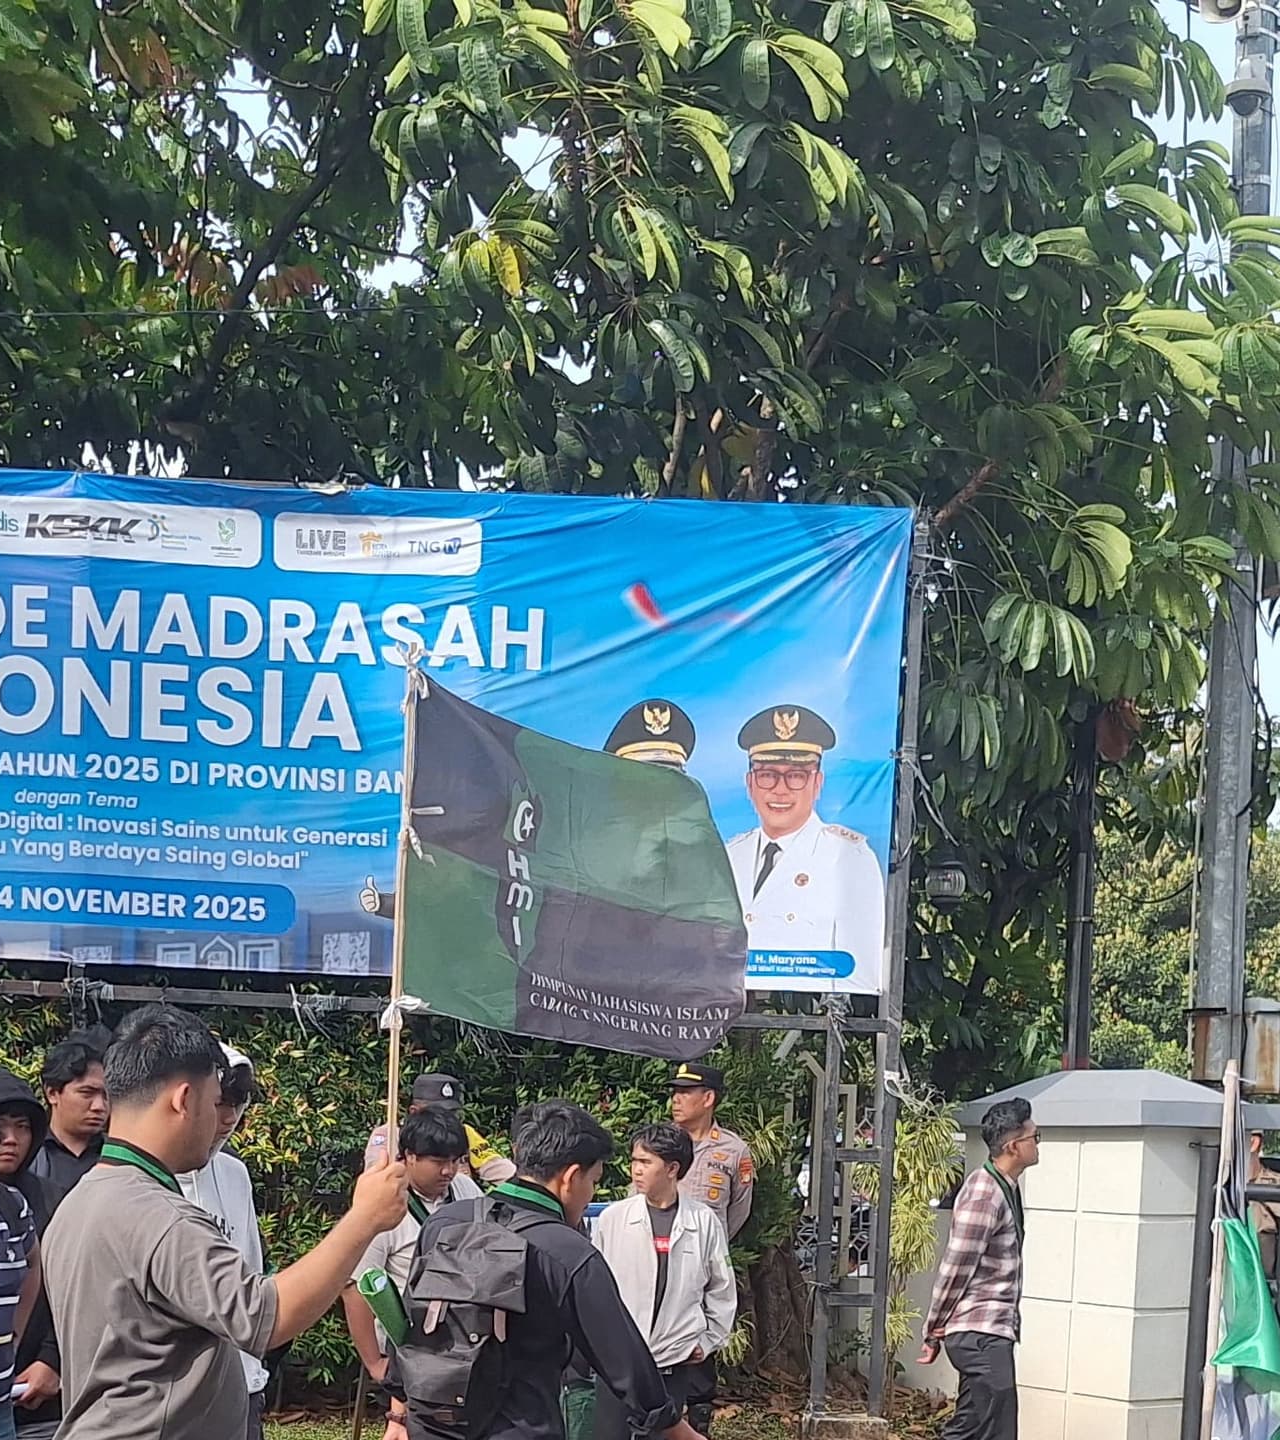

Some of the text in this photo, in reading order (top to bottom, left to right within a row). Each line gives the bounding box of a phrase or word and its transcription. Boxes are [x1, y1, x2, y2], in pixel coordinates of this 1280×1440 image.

[296, 529, 346, 550] LIVE
[408, 540, 440, 553] TNG
[71, 585, 545, 671] MADRASAH
[85, 753, 159, 783] 2025
[170, 760, 199, 786] DI
[208, 762, 345, 793] PROVINSI
[14, 789, 138, 809] dengan Tema
[77, 815, 156, 836] Inovasi
[161, 819, 220, 840] Sains
[225, 824, 288, 844] untuk
[293, 826, 387, 847] Generasi
[12, 838, 64, 862] Yang
[69, 842, 160, 866] Berdaya
[165, 846, 226, 871] Saing
[21, 886, 186, 919] NOVEMBER
[193, 895, 266, 921] 2025
[755, 954, 766, 964] H.
[590, 991, 672, 1020] MAHASISWA
[677, 1007, 730, 1021] ISLAM
[581, 1008, 672, 1038] TANGERANG
[678, 1026, 725, 1040] RAYA
